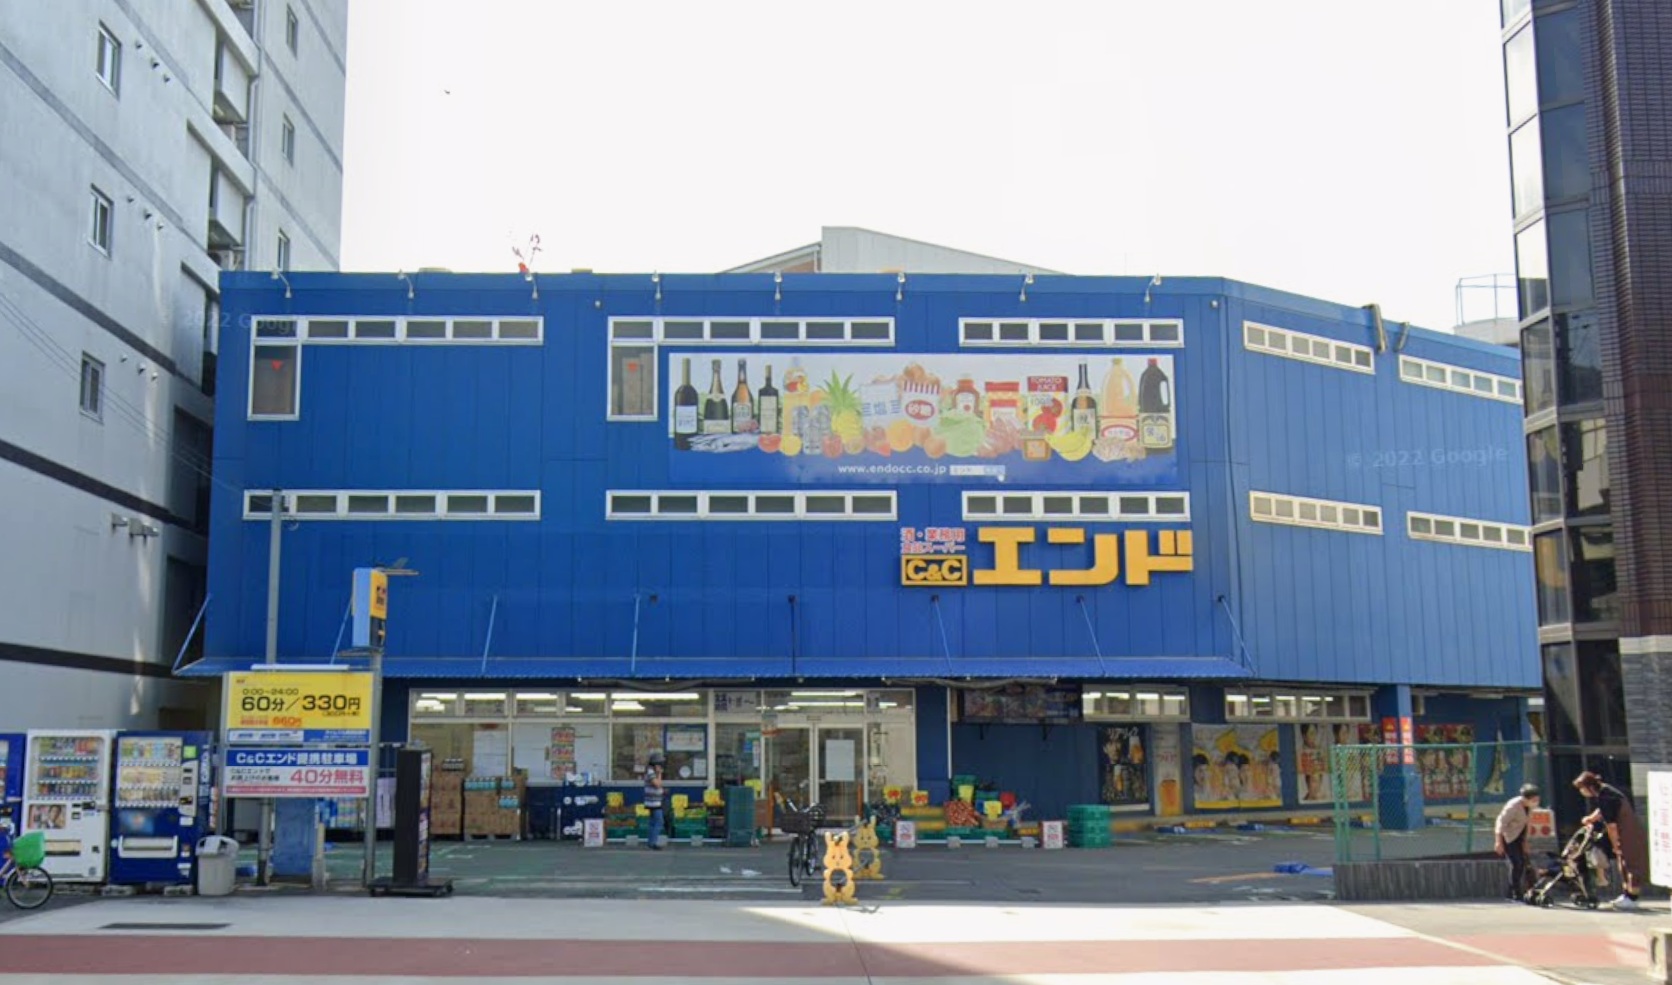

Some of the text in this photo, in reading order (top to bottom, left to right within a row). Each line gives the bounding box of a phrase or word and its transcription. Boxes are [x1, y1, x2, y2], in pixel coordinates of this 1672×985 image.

[838, 464, 947, 476] www.endocc.co.jp
[973, 527, 1194, 585] エンド
[906, 559, 962, 581] C&C
[290, 768, 364, 784] 40分無料
